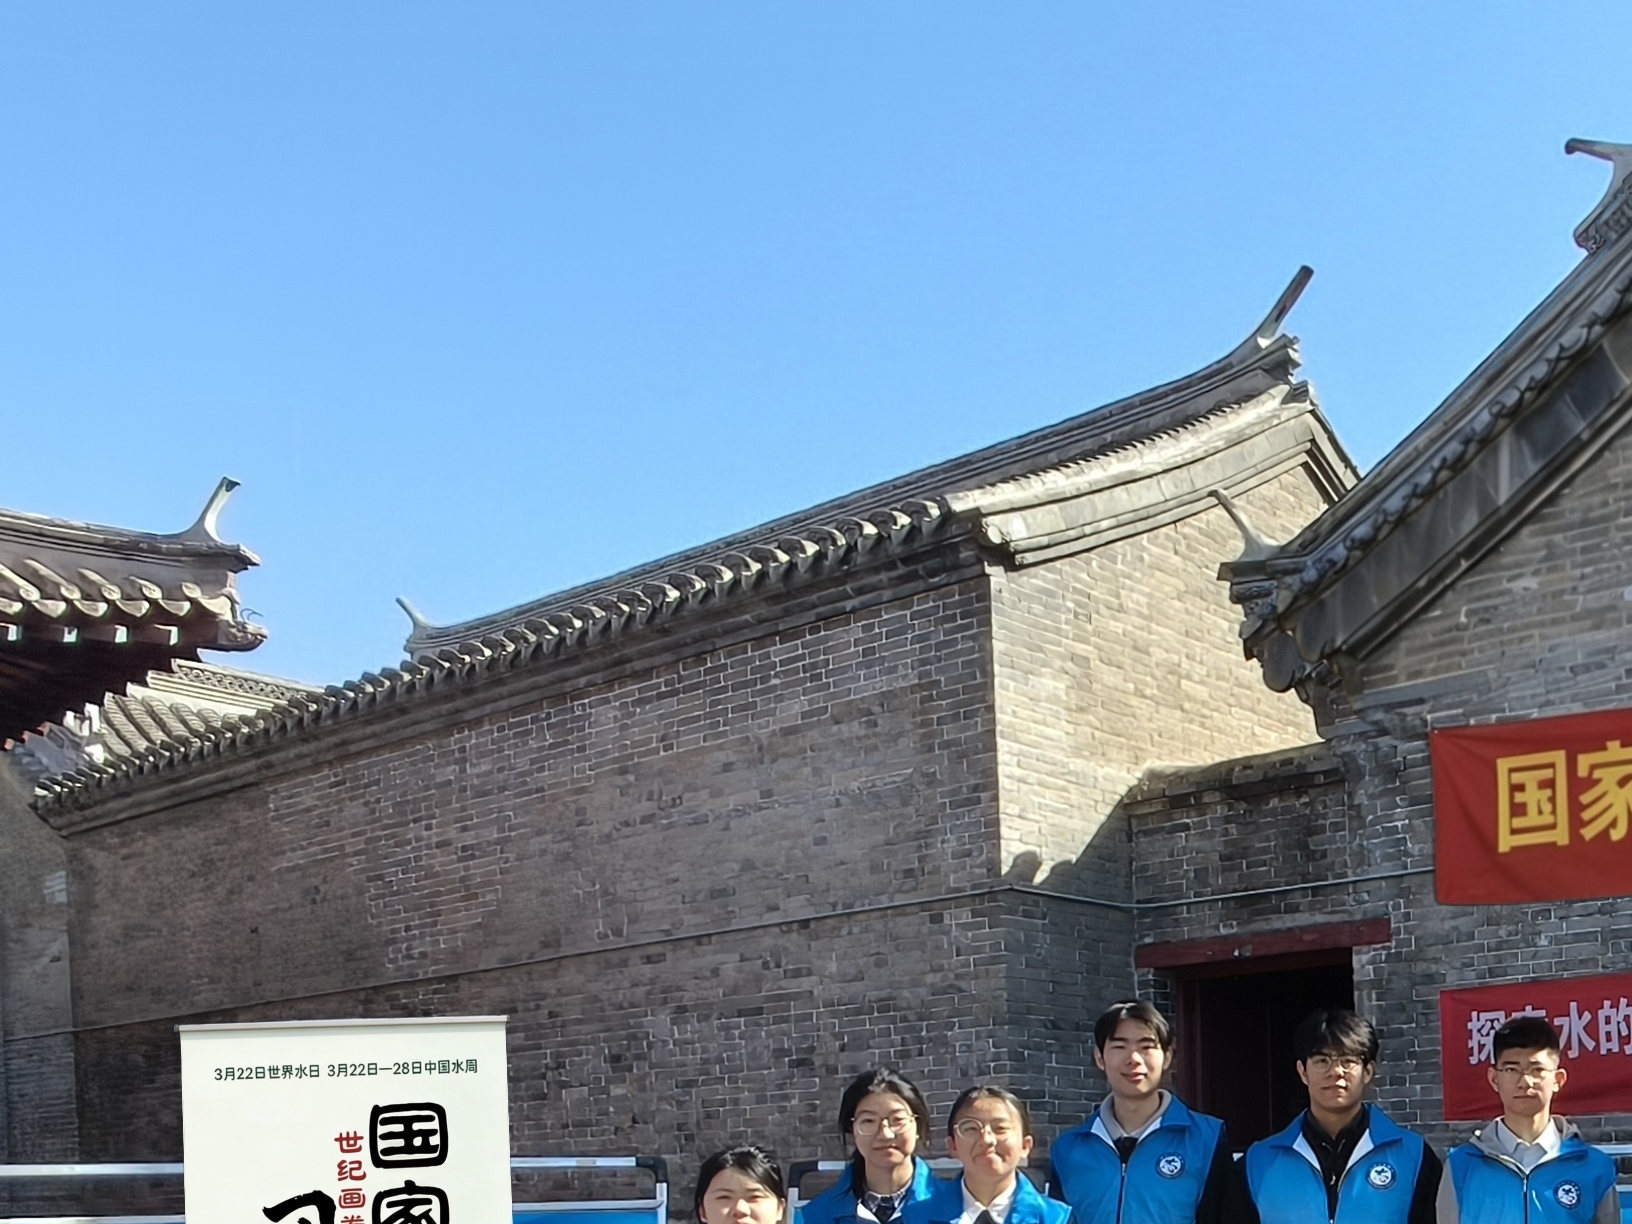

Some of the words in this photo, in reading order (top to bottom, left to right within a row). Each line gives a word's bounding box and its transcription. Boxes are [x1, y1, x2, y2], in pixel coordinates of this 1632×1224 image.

[214, 1064, 320, 1081] 3月22日世界水日
[327, 1059, 478, 1078] 3月22日—28日中国水周
